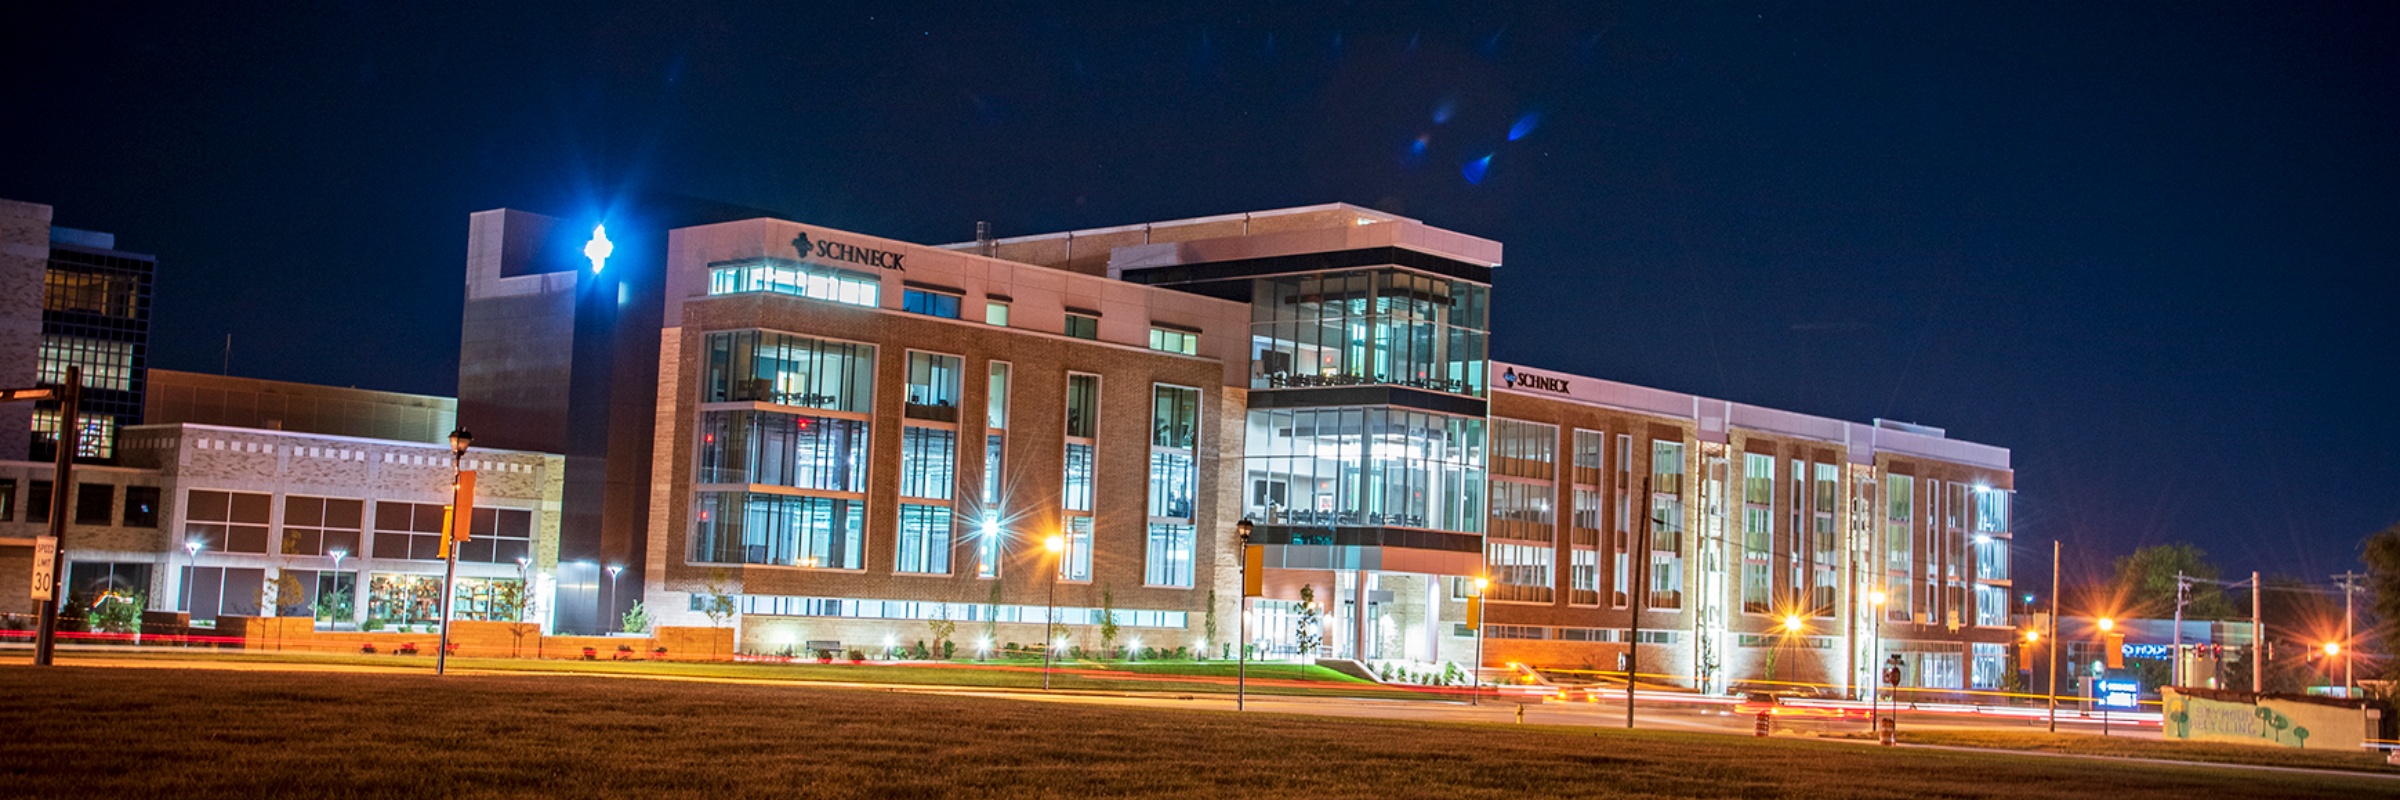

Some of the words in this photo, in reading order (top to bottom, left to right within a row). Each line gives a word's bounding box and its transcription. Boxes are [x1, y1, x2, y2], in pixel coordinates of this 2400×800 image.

[816, 239, 905, 271] SCHNECK
[1517, 372, 1570, 394] SCHNECK
[37, 543, 55, 554] SPEED
[34, 571, 51, 592] 30
